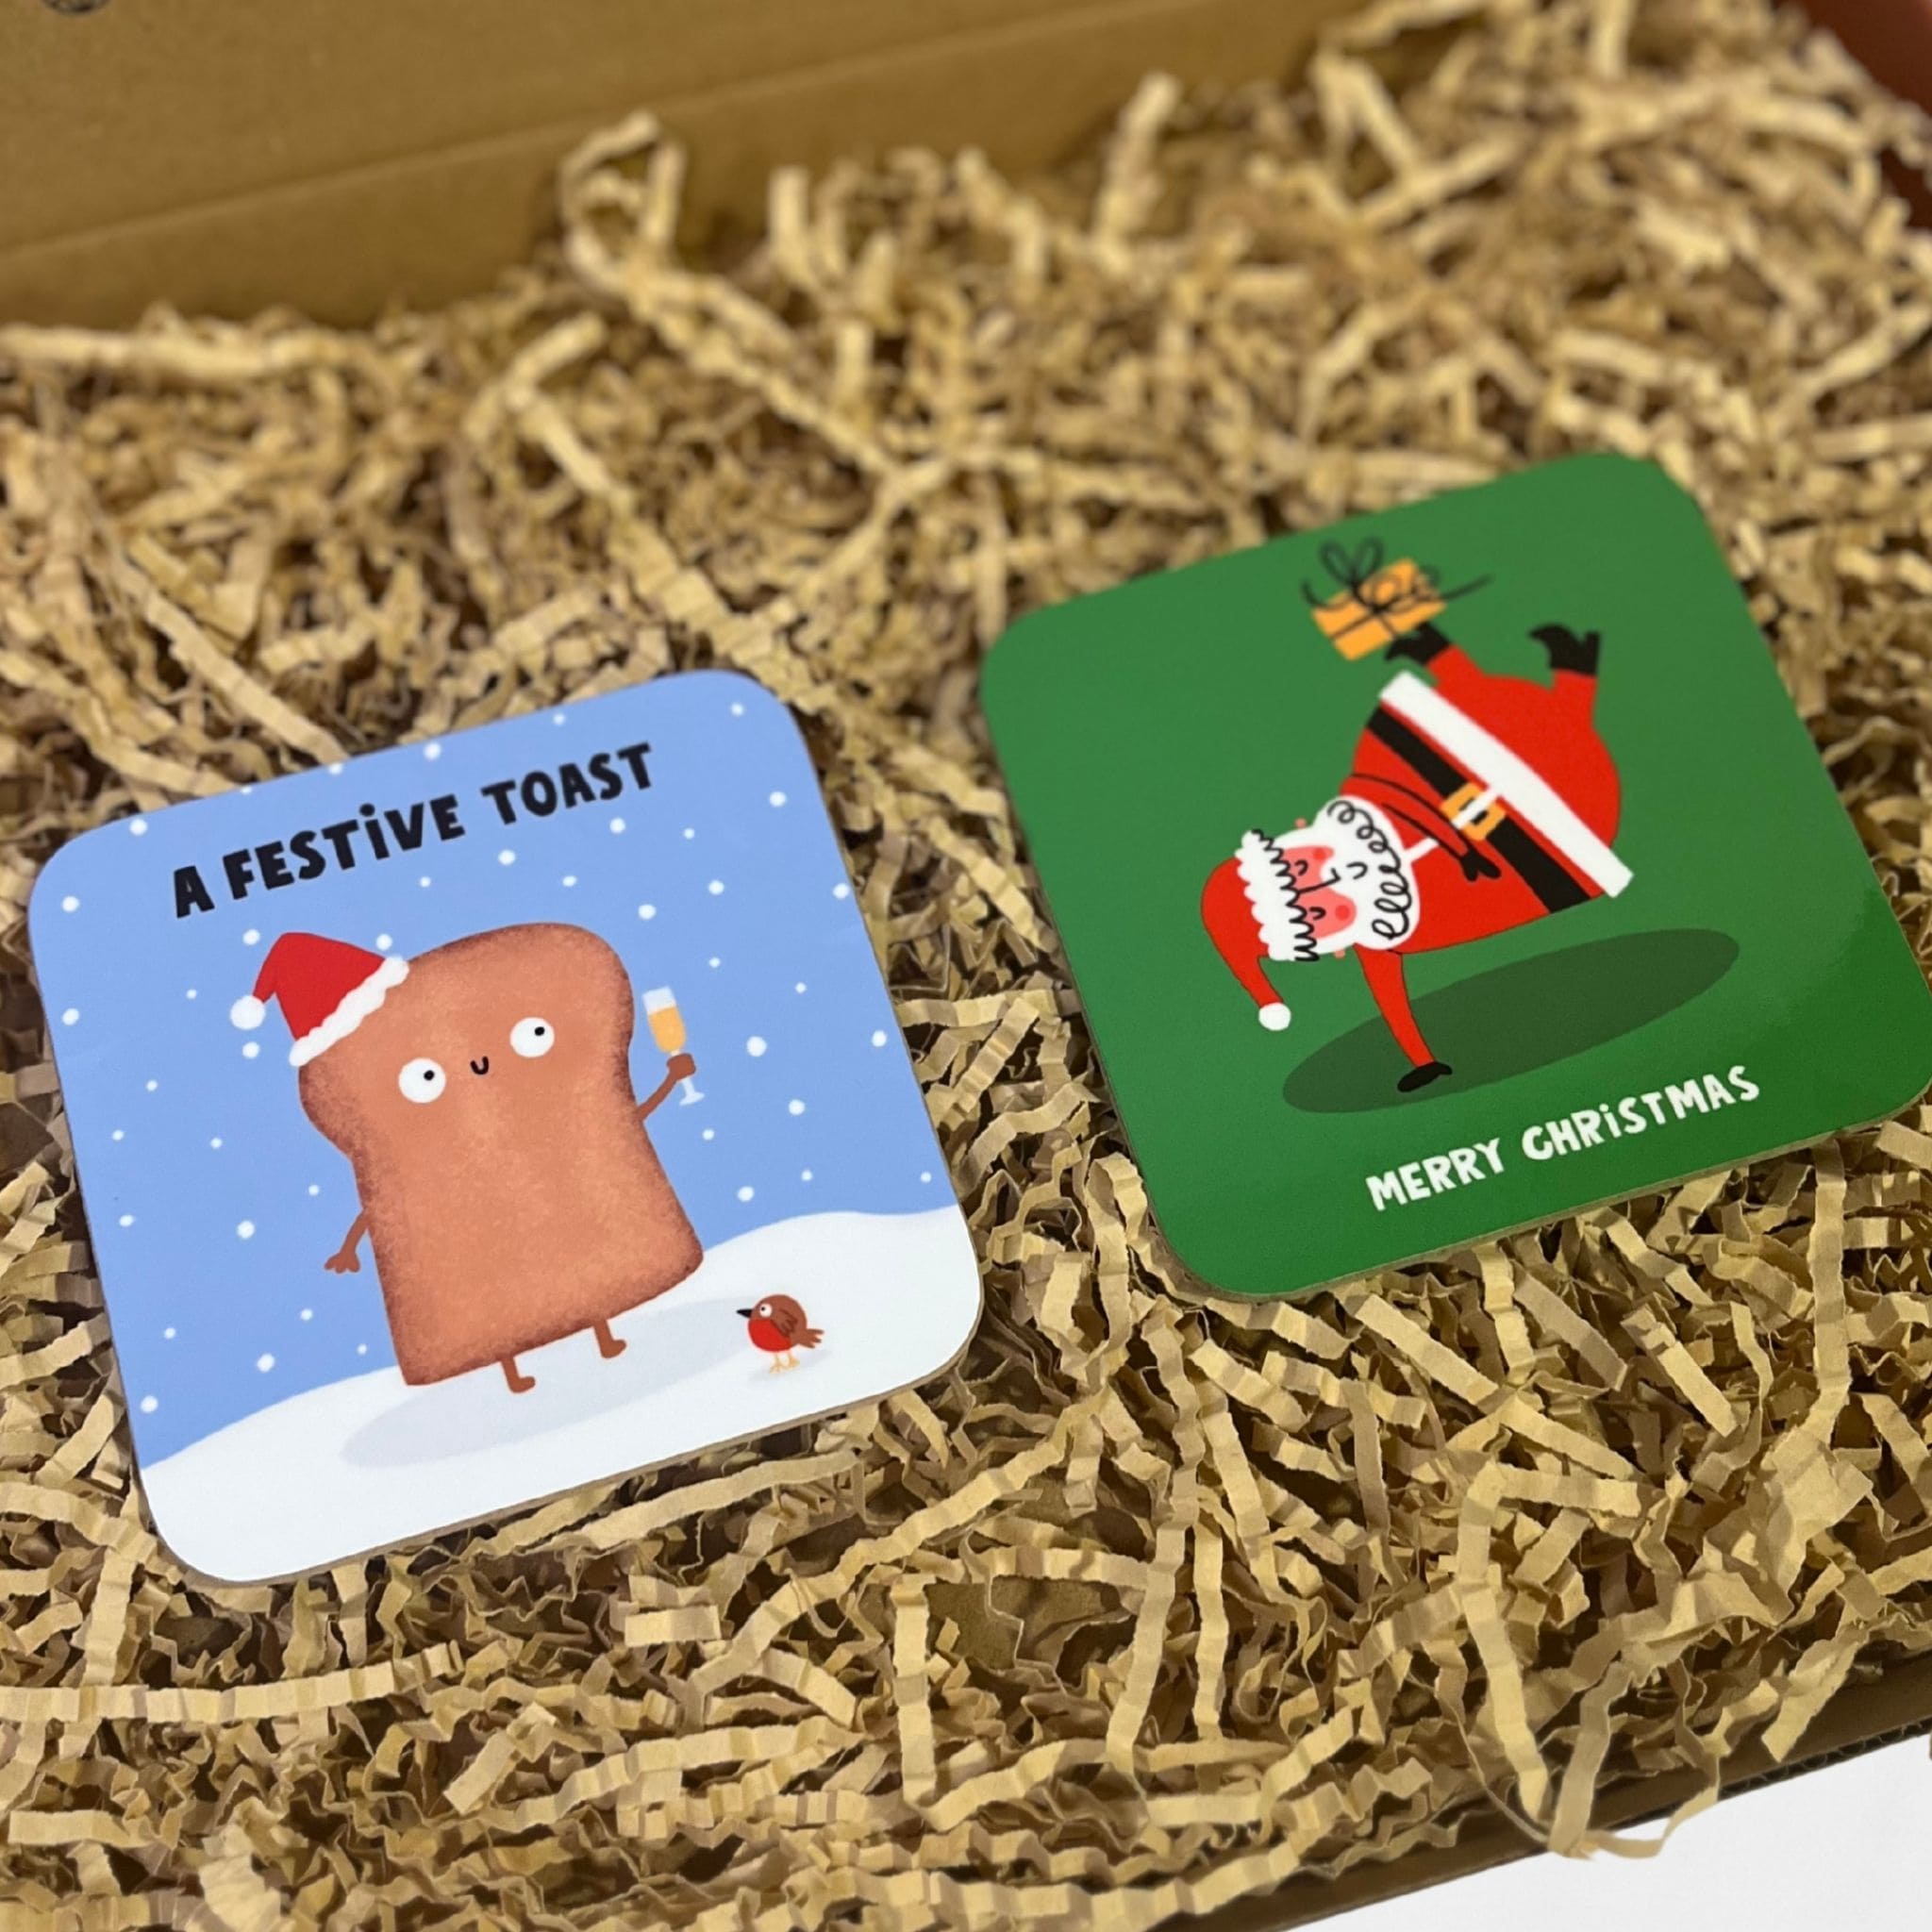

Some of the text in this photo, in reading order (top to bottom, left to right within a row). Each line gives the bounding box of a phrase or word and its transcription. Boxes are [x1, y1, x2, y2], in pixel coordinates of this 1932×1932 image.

[174, 865, 215, 919] A
[480, 742, 653, 825] TOAST
[1366, 1138, 1506, 1211] MERRY
